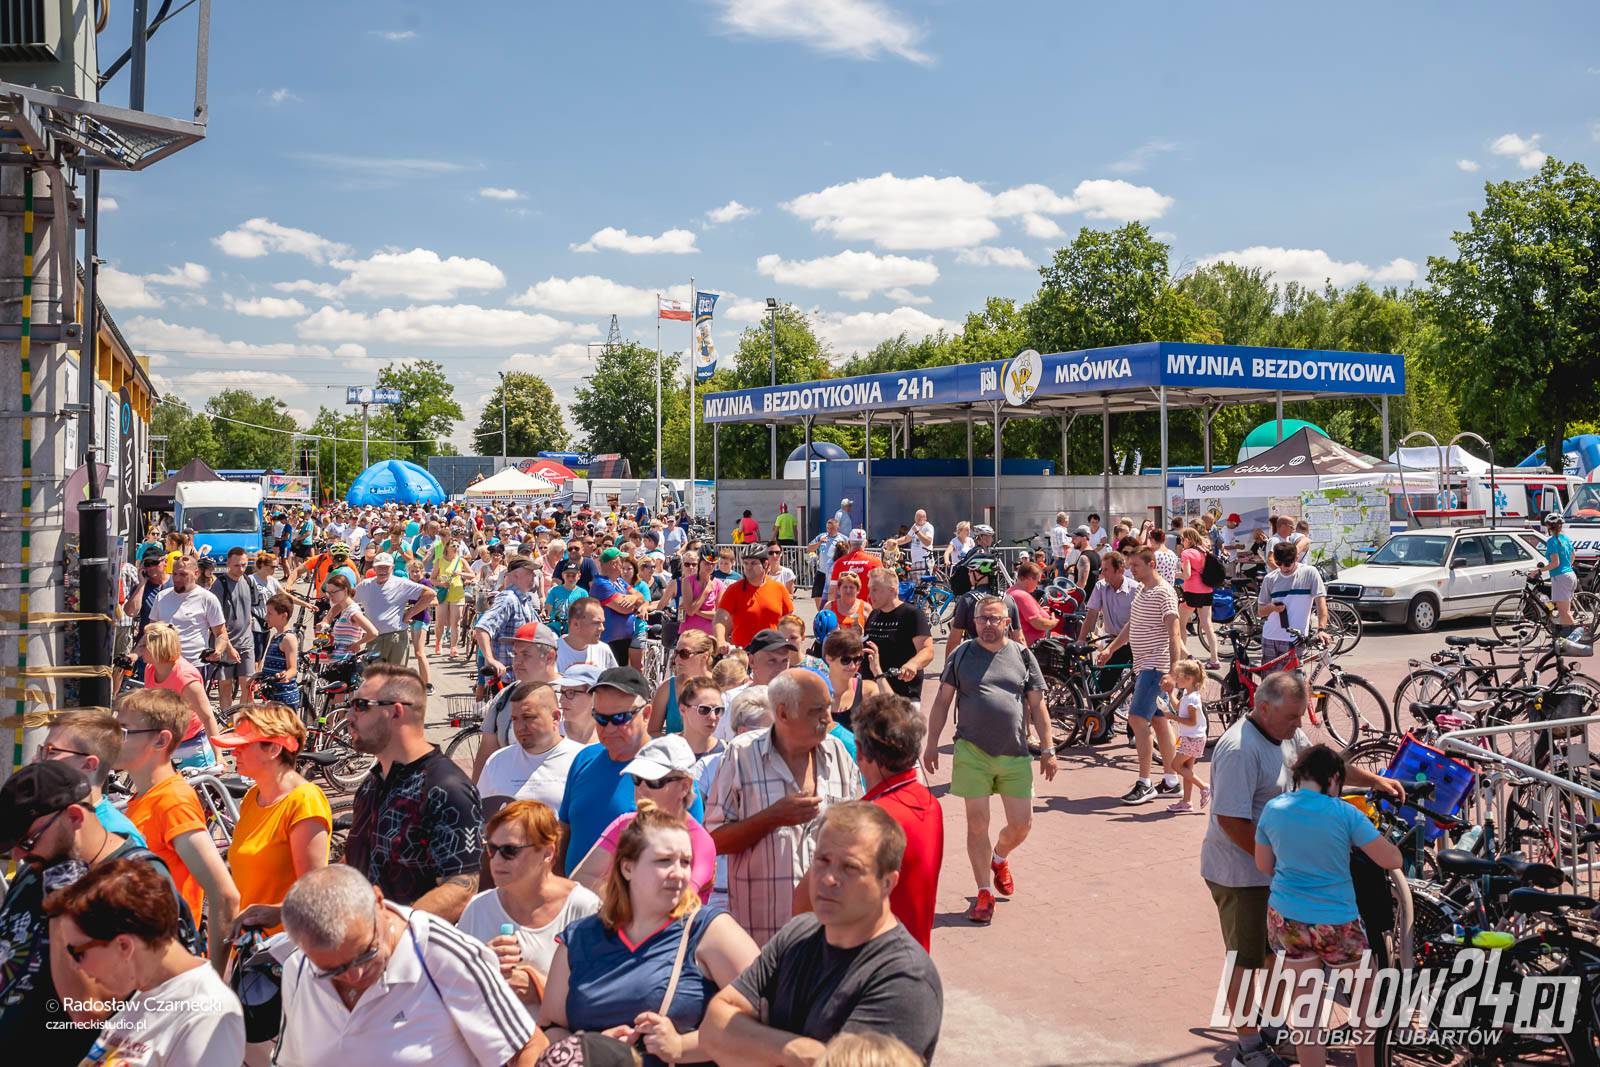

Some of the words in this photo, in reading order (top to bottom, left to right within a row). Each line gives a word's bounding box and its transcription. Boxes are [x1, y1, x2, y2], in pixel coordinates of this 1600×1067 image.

[980, 367, 997, 396] psb
[1055, 356, 1132, 384] MRÓWKA
[1166, 354, 1245, 377] MYJNIA
[1252, 358, 1396, 384] BEZDOTYKOWA
[705, 394, 753, 419] MYJNIA
[763, 381, 882, 413] BEZDOTYKOWA
[1234, 464, 1285, 474] Global
[1196, 484, 1230, 494] Agentools
